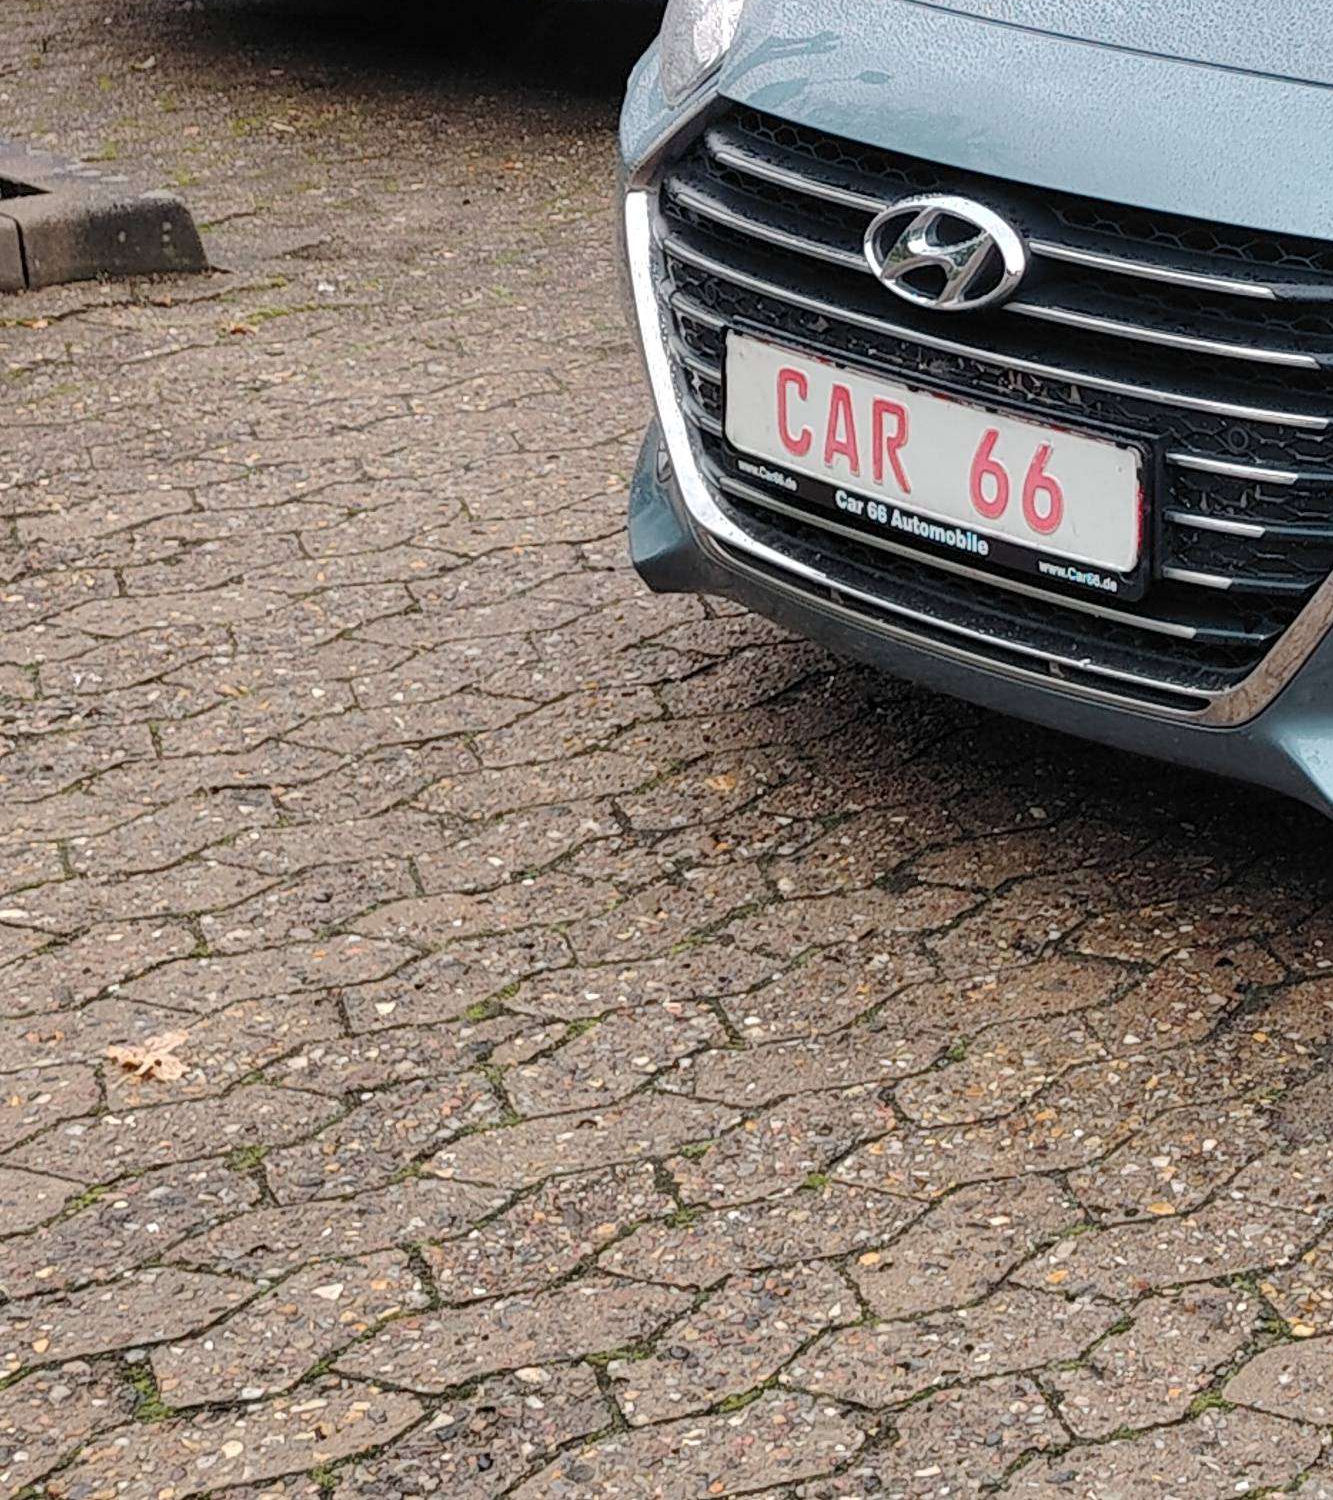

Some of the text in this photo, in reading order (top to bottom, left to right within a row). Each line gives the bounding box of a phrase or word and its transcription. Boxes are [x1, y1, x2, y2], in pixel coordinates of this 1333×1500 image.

[777, 367, 1065, 535] CAR 66
[835, 489, 990, 556] Car 66 Automobile
